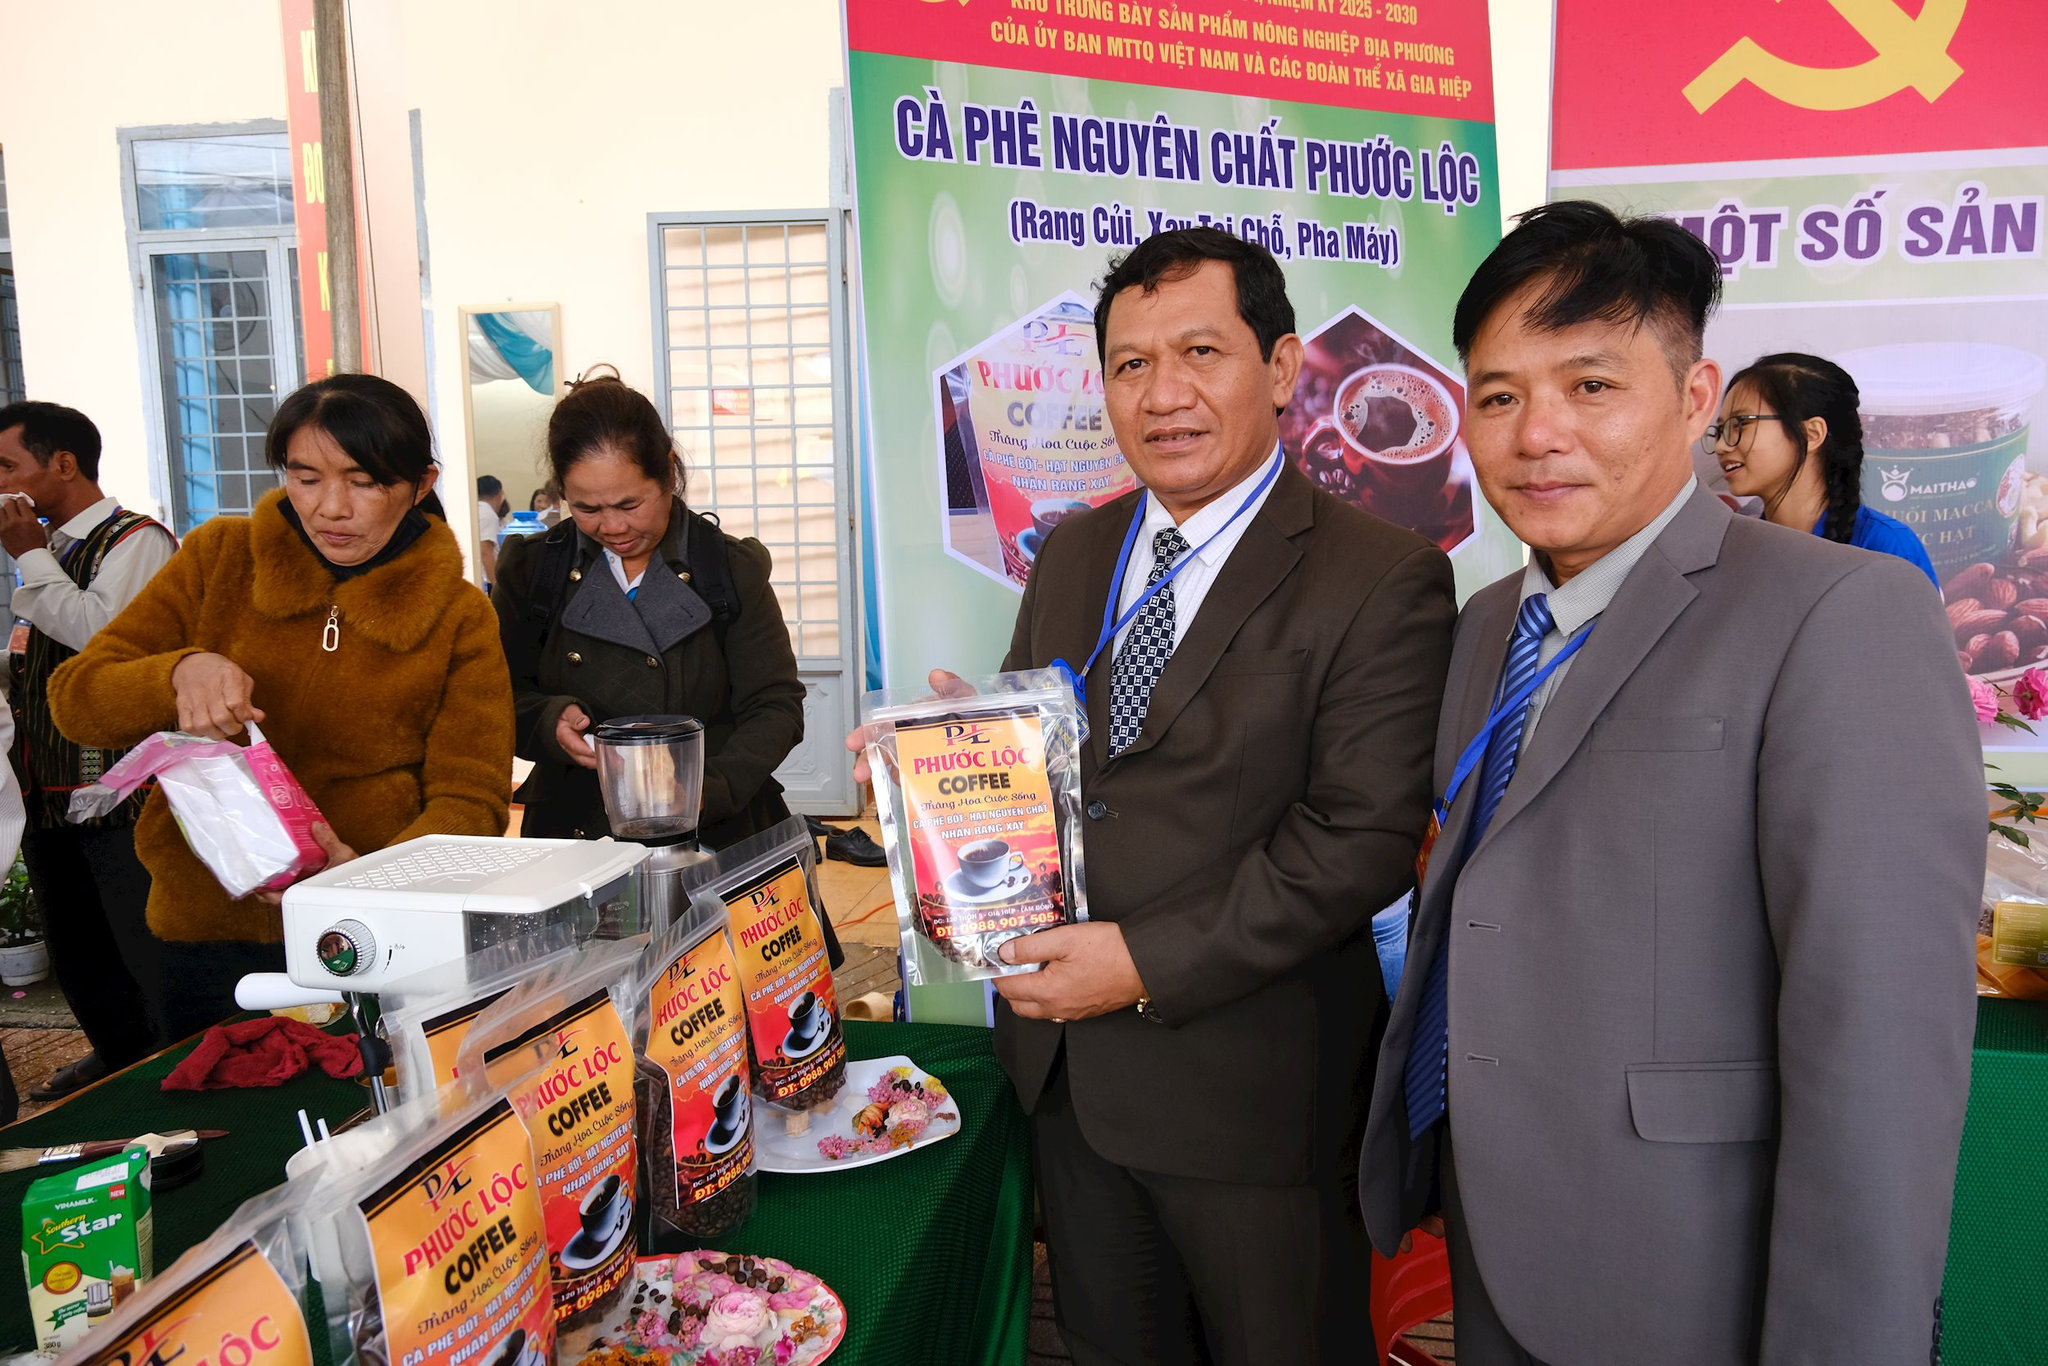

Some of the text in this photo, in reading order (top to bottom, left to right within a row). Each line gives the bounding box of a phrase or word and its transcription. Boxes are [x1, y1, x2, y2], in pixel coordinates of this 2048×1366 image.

[1339, 0, 1373, 19] 2025
[1385, 3, 1418, 25] 2030
[1118, 0, 1153, 27] BÀY
[1158, 3, 1194, 32] SẢN
[1198, 10, 1249, 40] PHẨM
[1253, 19, 1299, 46] NÔNG
[1303, 28, 1360, 57] NGHIỆP
[1363, 37, 1390, 61] ĐỊA
[1394, 41, 1455, 66] PHƯƠNG
[990, 16, 1472, 102] CỦA ỦY BAN MTTQ VIỆT NAM VÀ CÁC ĐOÀN THỂ XÃ GIA HIỆP
[897, 89, 1479, 213] CÀ PHÊ NGUYÊN CHẤT PHƯỚC LỘC
[1011, 202, 1085, 246] (Rang
[1298, 222, 1340, 259] Pha
[1347, 224, 1400, 266] Máy)
[1672, 187, 2038, 275] ỘT SỐ SẢN
[977, 360, 1073, 394] PHƯỚC
[1007, 401, 1103, 431] COFFEE
[996, 452, 1016, 468] PHÊ
[1046, 460, 1068, 475] HẠT
[1070, 457, 1112, 473] NGUYÊN
[1050, 479, 1087, 492] RANG
[1090, 475, 1112, 490] XAY
[1933, 499, 1993, 522] MACCA
[1940, 526, 1974, 544] HẠT
[913, 745, 1031, 775] PHƯỚC LỘC
[938, 772, 1011, 796] COFFEE
[958, 797, 982, 807] Hoa
[984, 793, 1009, 804] Cuộc
[1011, 792, 1037, 802] Sống
[970, 810, 987, 822] HẠT
[989, 805, 1024, 820] NGUYÊN
[1025, 800, 1049, 815] CHẤT
[973, 823, 1004, 835] RANG
[1006, 820, 1025, 831] XAY
[740, 896, 804, 949] PHƯỚC LỘC
[959, 911, 1055, 934] 0988 907 505
[761, 924, 802, 963] COFFEE
[700, 963, 732, 996] LỘC
[670, 997, 725, 1047] COFFEE
[583, 1041, 621, 1080] LỘC
[694, 1038, 711, 1053] Hoa
[799, 1066, 823, 1088] 0988
[823, 1054, 837, 1070] 907
[547, 1080, 613, 1138] COFFEE
[573, 1128, 593, 1148] Hoa
[592, 1113, 615, 1131] Cuộc
[545, 1166, 567, 1185] PHÊ
[600, 1122, 628, 1150] NGUYÊN
[592, 1152, 615, 1178] RANG
[615, 1140, 630, 1160] XAY
[717, 1163, 742, 1188] 0988
[55, 1197, 94, 1210] VINAMILK
[110, 1189, 125, 1198] NEW
[45, 1214, 87, 1236] Southern
[60, 1212, 123, 1243] Star
[403, 1162, 528, 1277] PHƯỚC LỘC
[444, 1215, 517, 1296] COFFEE
[470, 1278, 494, 1302] Hoa
[561, 1291, 575, 1302] 120
[576, 1258, 630, 1310] 0988 907
[490, 1302, 520, 1337] RANG
[402, 1346, 425, 1366] CÀ
[427, 1329, 455, 1358] PHÊ
